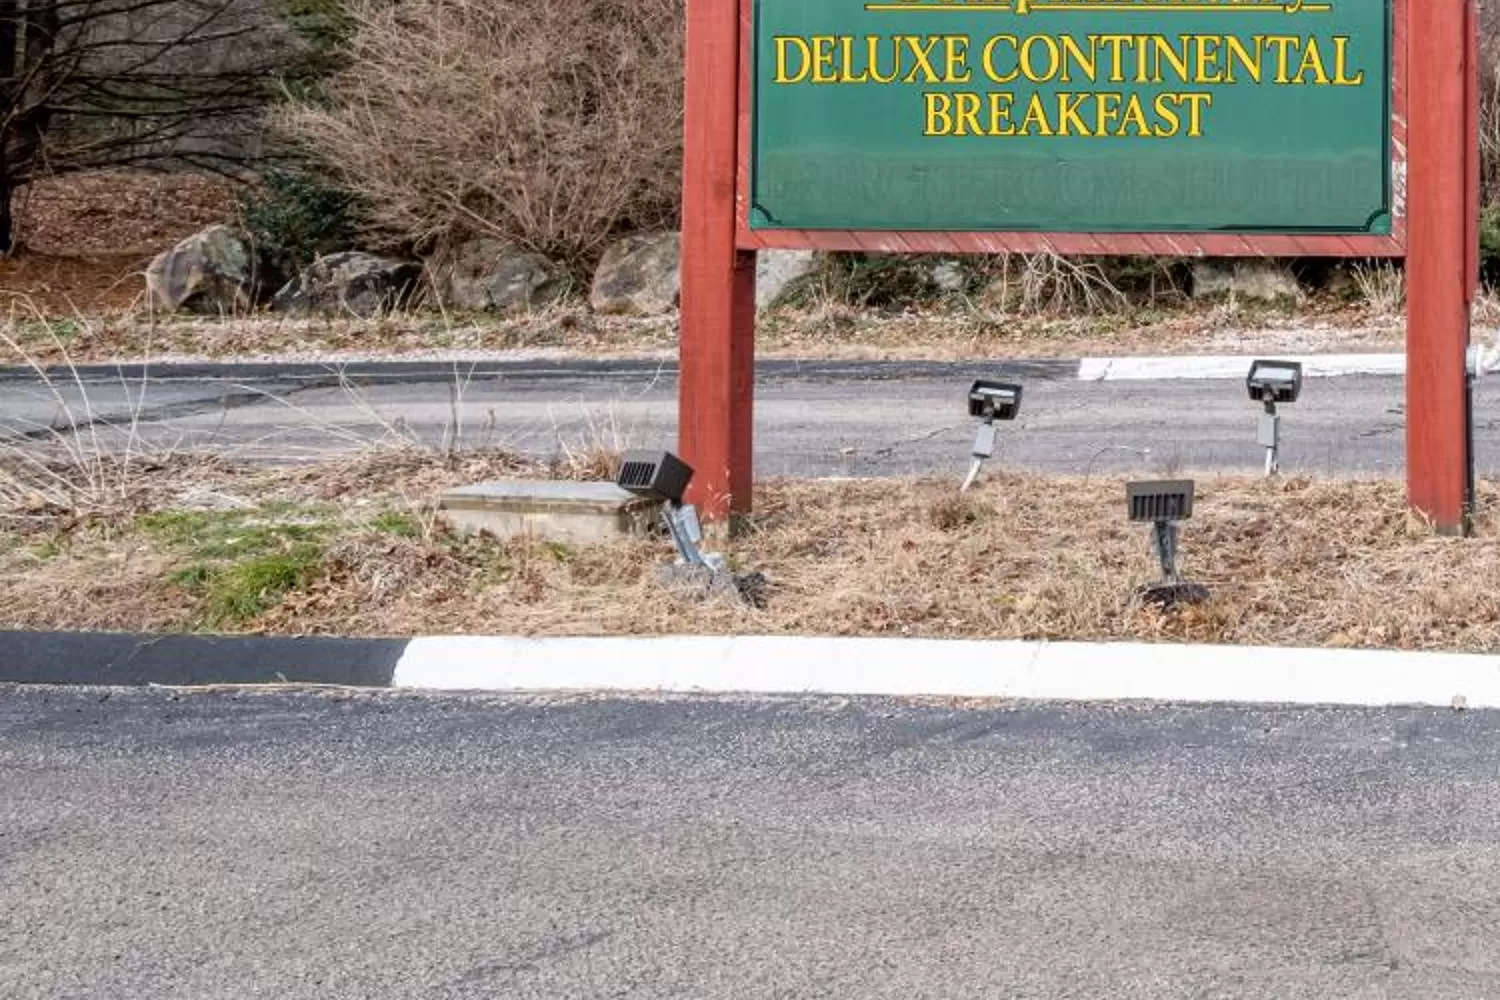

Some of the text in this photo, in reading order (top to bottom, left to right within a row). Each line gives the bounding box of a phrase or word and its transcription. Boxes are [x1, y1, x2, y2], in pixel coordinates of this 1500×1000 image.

[773, 34, 1364, 86] DELUXE CONTINENTAL
[923, 92, 1212, 138] BREAKFAST
